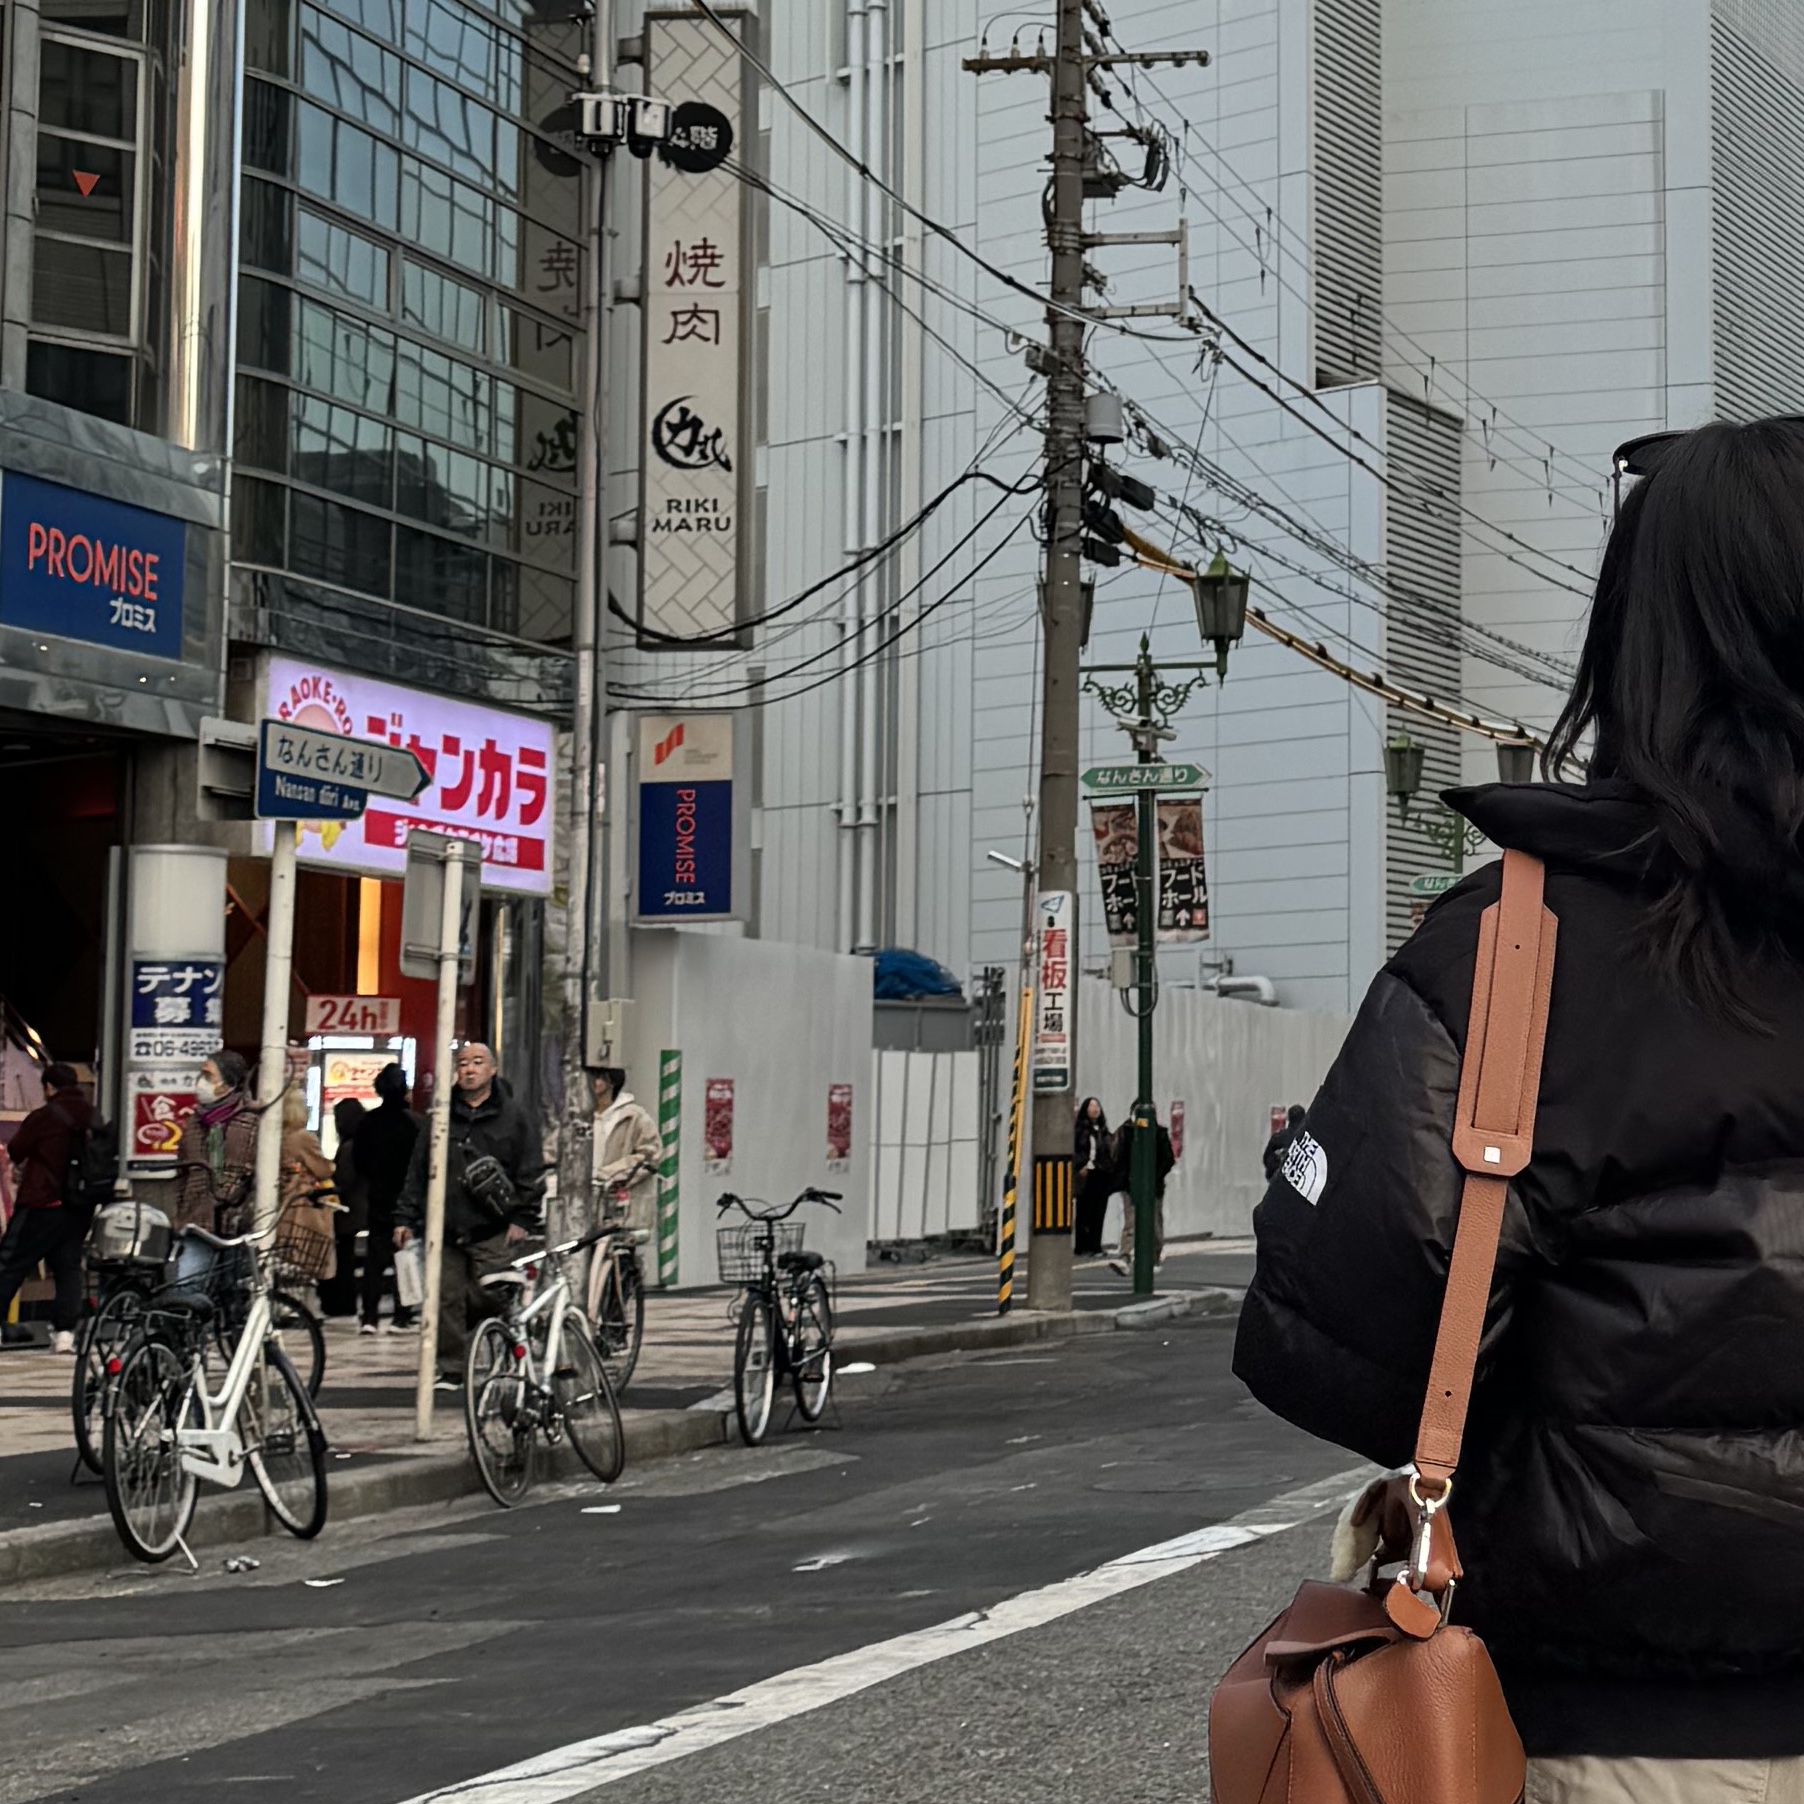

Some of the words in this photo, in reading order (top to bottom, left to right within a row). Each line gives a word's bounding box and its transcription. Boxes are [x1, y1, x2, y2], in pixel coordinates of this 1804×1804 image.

[663, 237, 726, 346] 焼肉
[666, 498, 718, 513] RIKI
[652, 517, 731, 532] MARU
[29, 522, 159, 601] PROMISE
[109, 597, 156, 633] プロミス
[278, 734, 383, 784] なんさん通り
[1097, 767, 1188, 785] なんさん通り
[675, 788, 697, 884] PROMISE
[1161, 865, 1205, 888] フード
[1106, 892, 1139, 913] ホー
[1161, 886, 1207, 910] ホール
[137, 966, 222, 994] テナン
[317, 1000, 377, 1031] 24h
